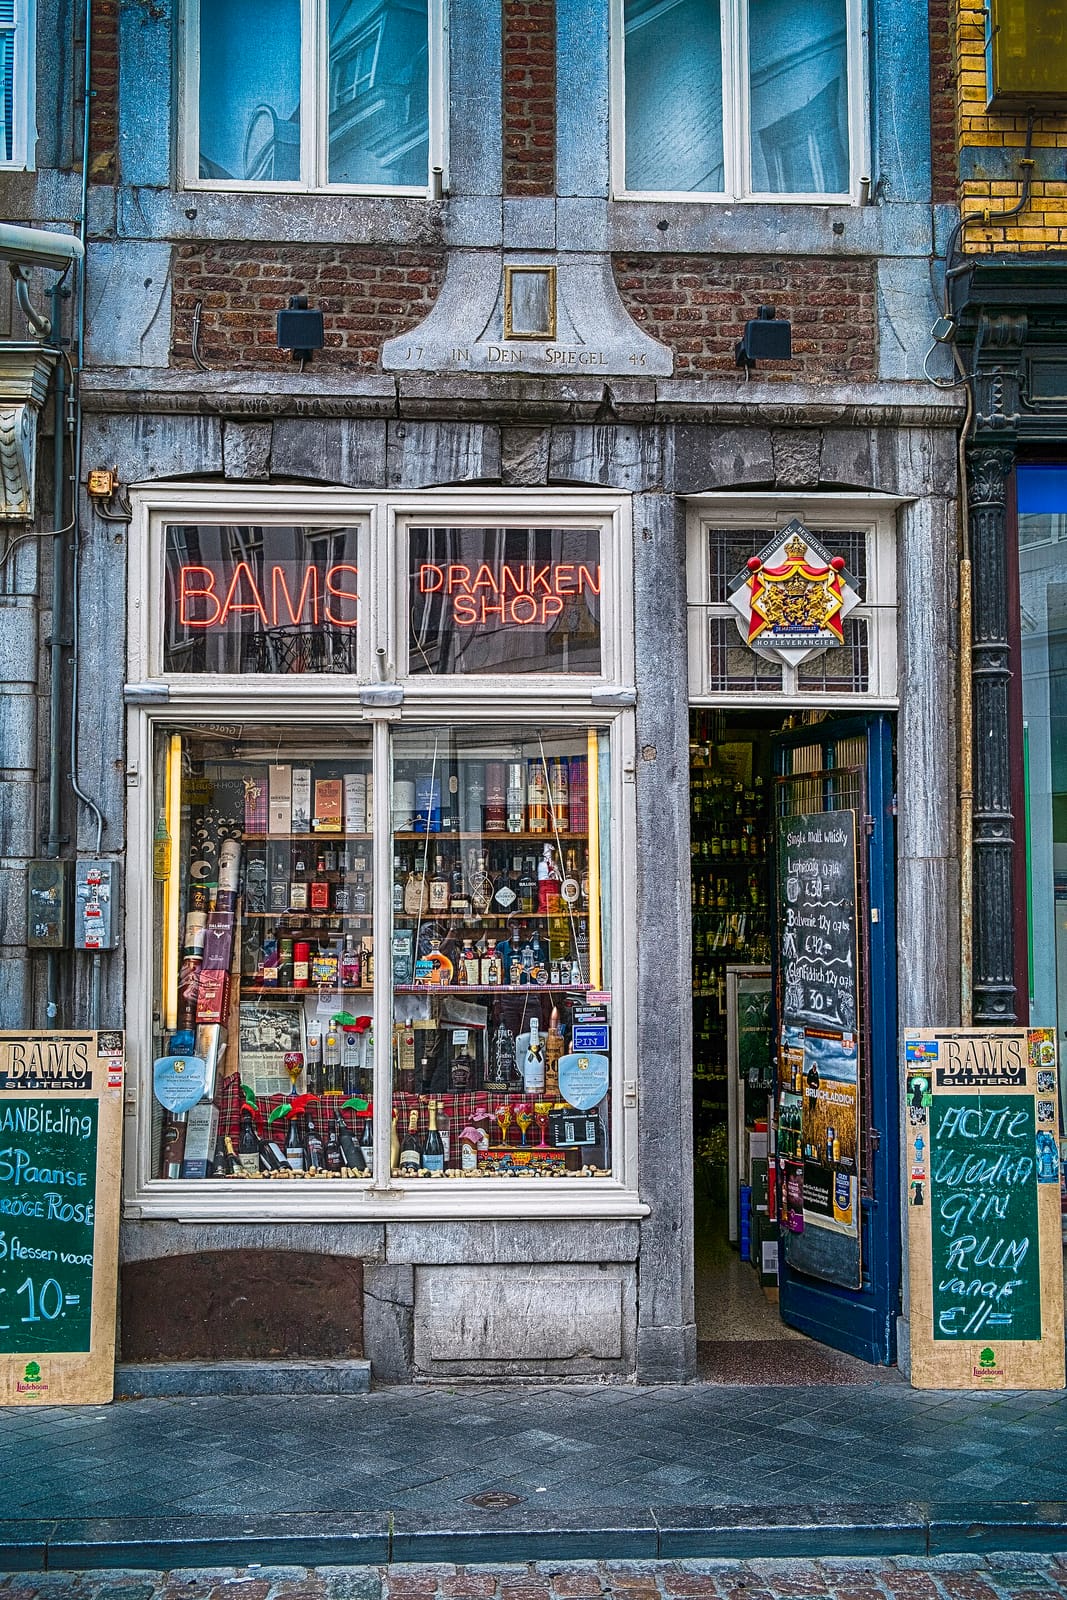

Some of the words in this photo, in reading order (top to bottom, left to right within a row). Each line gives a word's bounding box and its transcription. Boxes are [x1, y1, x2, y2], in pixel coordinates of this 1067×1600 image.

[452, 348, 470, 362] IN
[487, 346, 523, 363] DEN
[544, 347, 609, 365] SPIEGEL
[760, 526, 794, 561] KONINKLIJKE
[797, 526, 832, 561] BESCHIKKING
[419, 563, 601, 595] DRANKEN
[178, 561, 358, 627] BAMS
[452, 593, 565, 626] SHOP
[757, 639, 835, 647] HOFLEVERANCIER
[7, 1042, 89, 1080] BAMS
[943, 1040, 1023, 1077] BAMS
[5, 1081, 86, 1089] SLIJTERIJ
[943, 1077, 1021, 1086] SLIJTERIJ
[805, 1087, 854, 1105] BRUICHLADDICH
[945, 1234, 1030, 1274] RUM
[973, 1366, 1004, 1378] Lindeboom
[16, 1381, 49, 1393] Lindeboom
